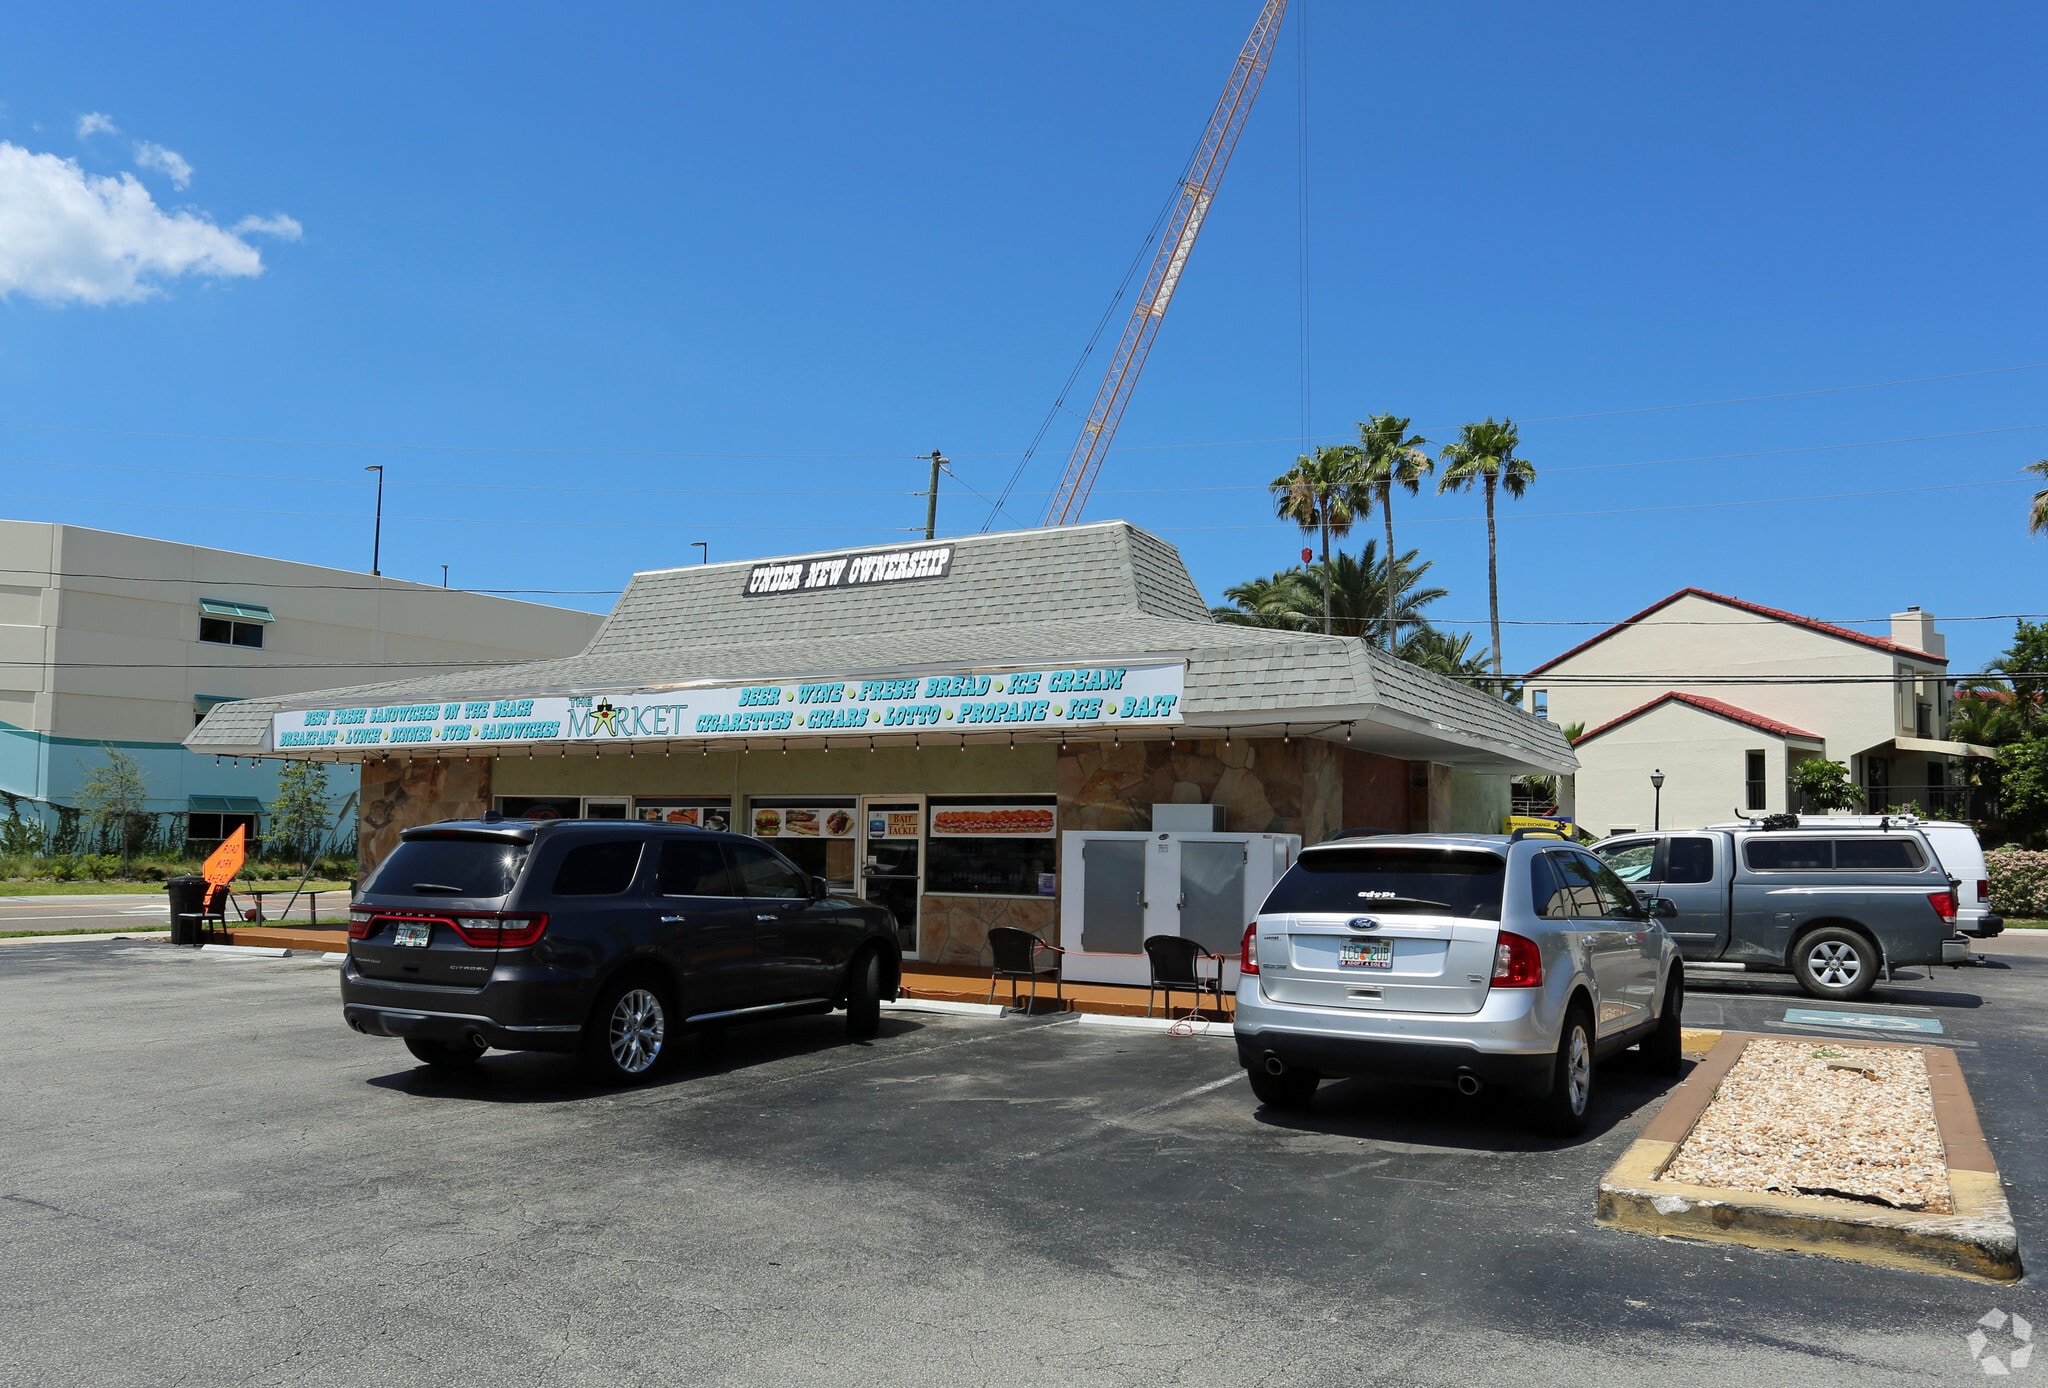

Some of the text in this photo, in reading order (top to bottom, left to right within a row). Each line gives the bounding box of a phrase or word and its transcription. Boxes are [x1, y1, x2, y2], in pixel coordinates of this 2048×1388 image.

[749, 548, 950, 594] UNDER NEW OWNERSHIP
[738, 668, 1127, 707] BEER WINE FRESH BREAD ICE CREAM
[569, 696, 593, 708] THE
[304, 700, 534, 726] BEST FRESH SANDWICHES ON THE BEACH
[695, 695, 1178, 732] CIGARETTES CIGARS LOTTO PROPANE ICE BAIT
[279, 721, 560, 746] BREAKFAST LUNCH DINNER SUBS SANDWICHES
[893, 814, 912, 823] BAIT
[888, 825, 918, 835] TACKLE
[223, 844, 240, 854] ROAD
[215, 859, 233, 868] WORK
[207, 873, 228, 883] AHEAD
[1354, 919, 1372, 928] Ford
